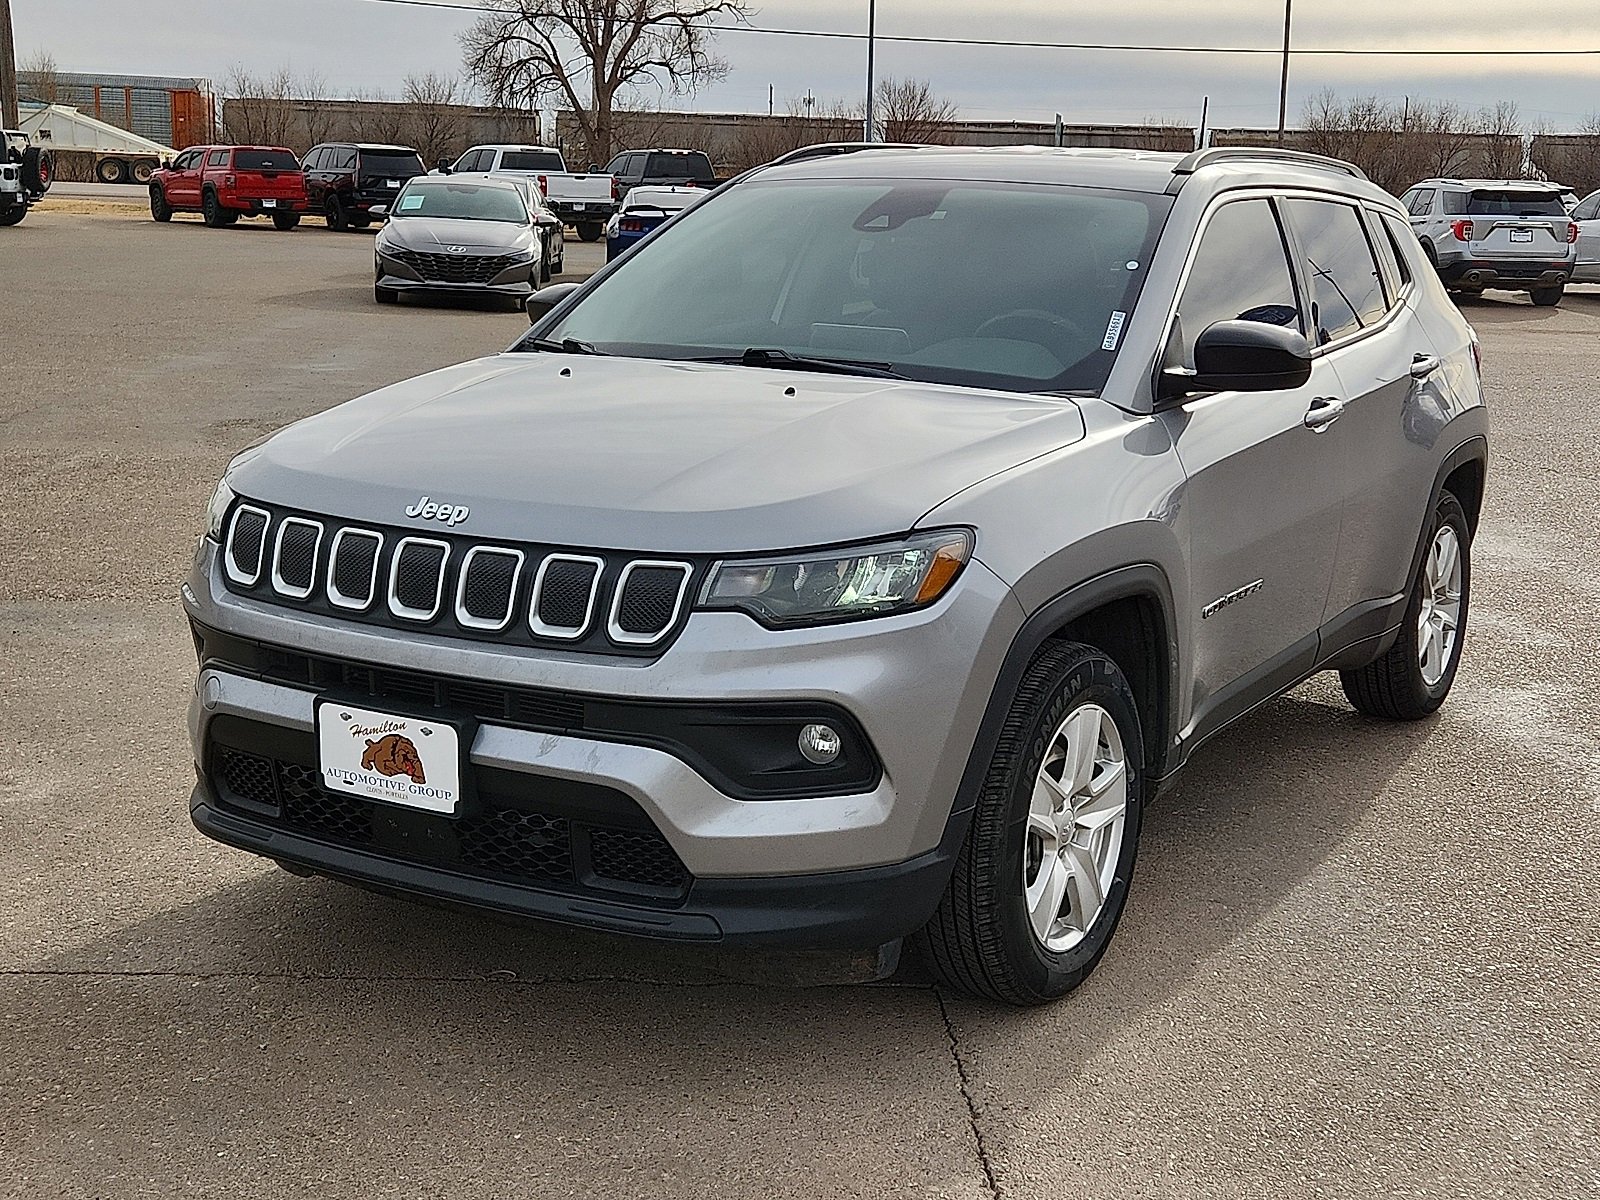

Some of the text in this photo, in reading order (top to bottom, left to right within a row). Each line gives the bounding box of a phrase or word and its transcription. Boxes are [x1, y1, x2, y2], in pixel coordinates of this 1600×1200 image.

[406, 496, 470, 527] Jeep
[350, 721, 407, 738] Hamilton
[1023, 675, 1081, 788] IRONMAN
[326, 768, 452, 800] AUTOMOTIVE GROUP
